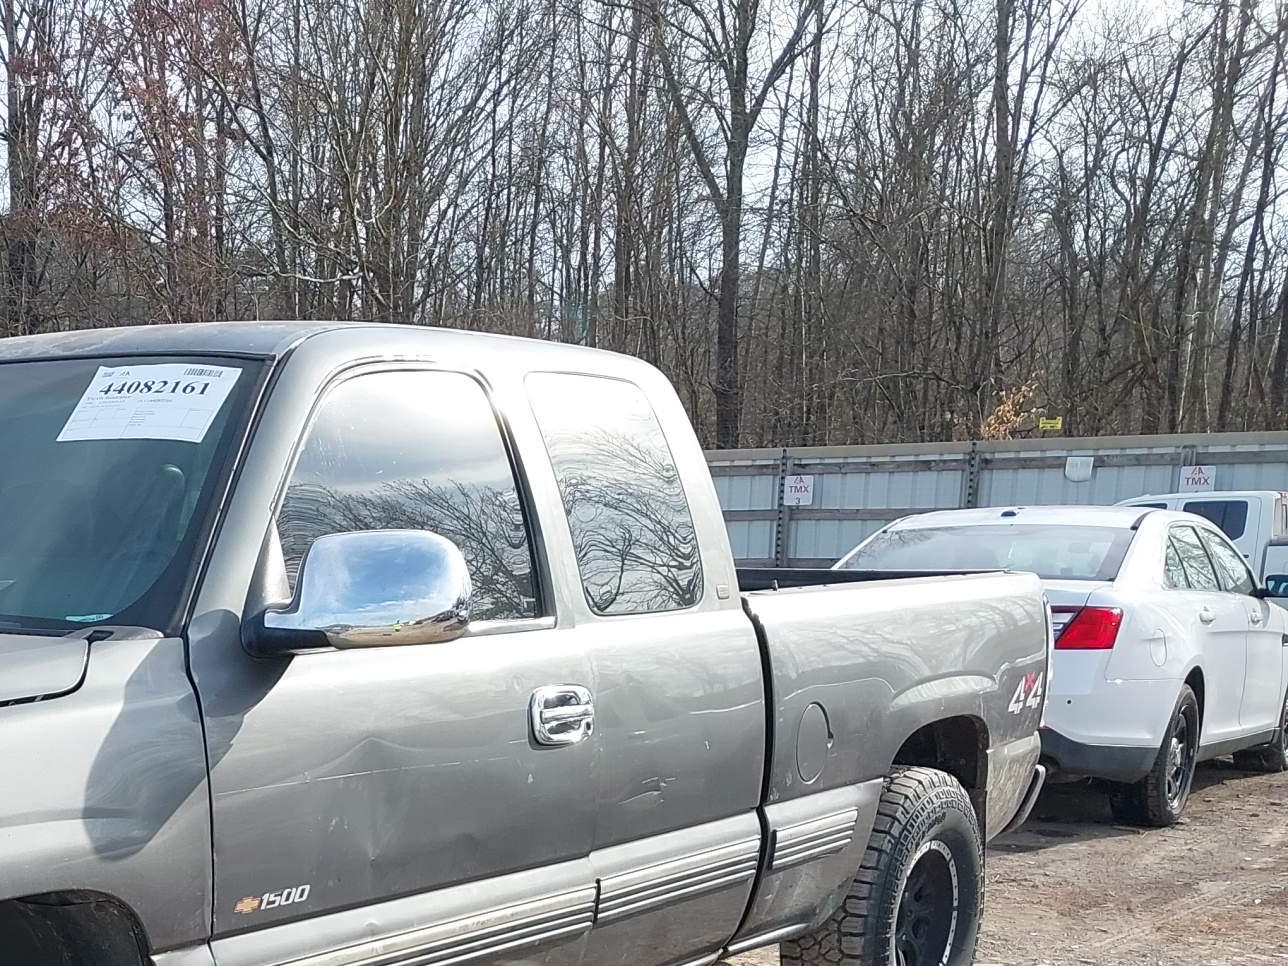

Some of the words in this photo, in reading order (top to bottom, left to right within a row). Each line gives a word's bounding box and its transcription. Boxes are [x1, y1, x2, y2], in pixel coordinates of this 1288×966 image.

[99, 380, 210, 395] 44082161
[1185, 476, 1210, 486] TMX
[789, 485, 809, 493] TMX
[260, 884, 311, 910] 1500
